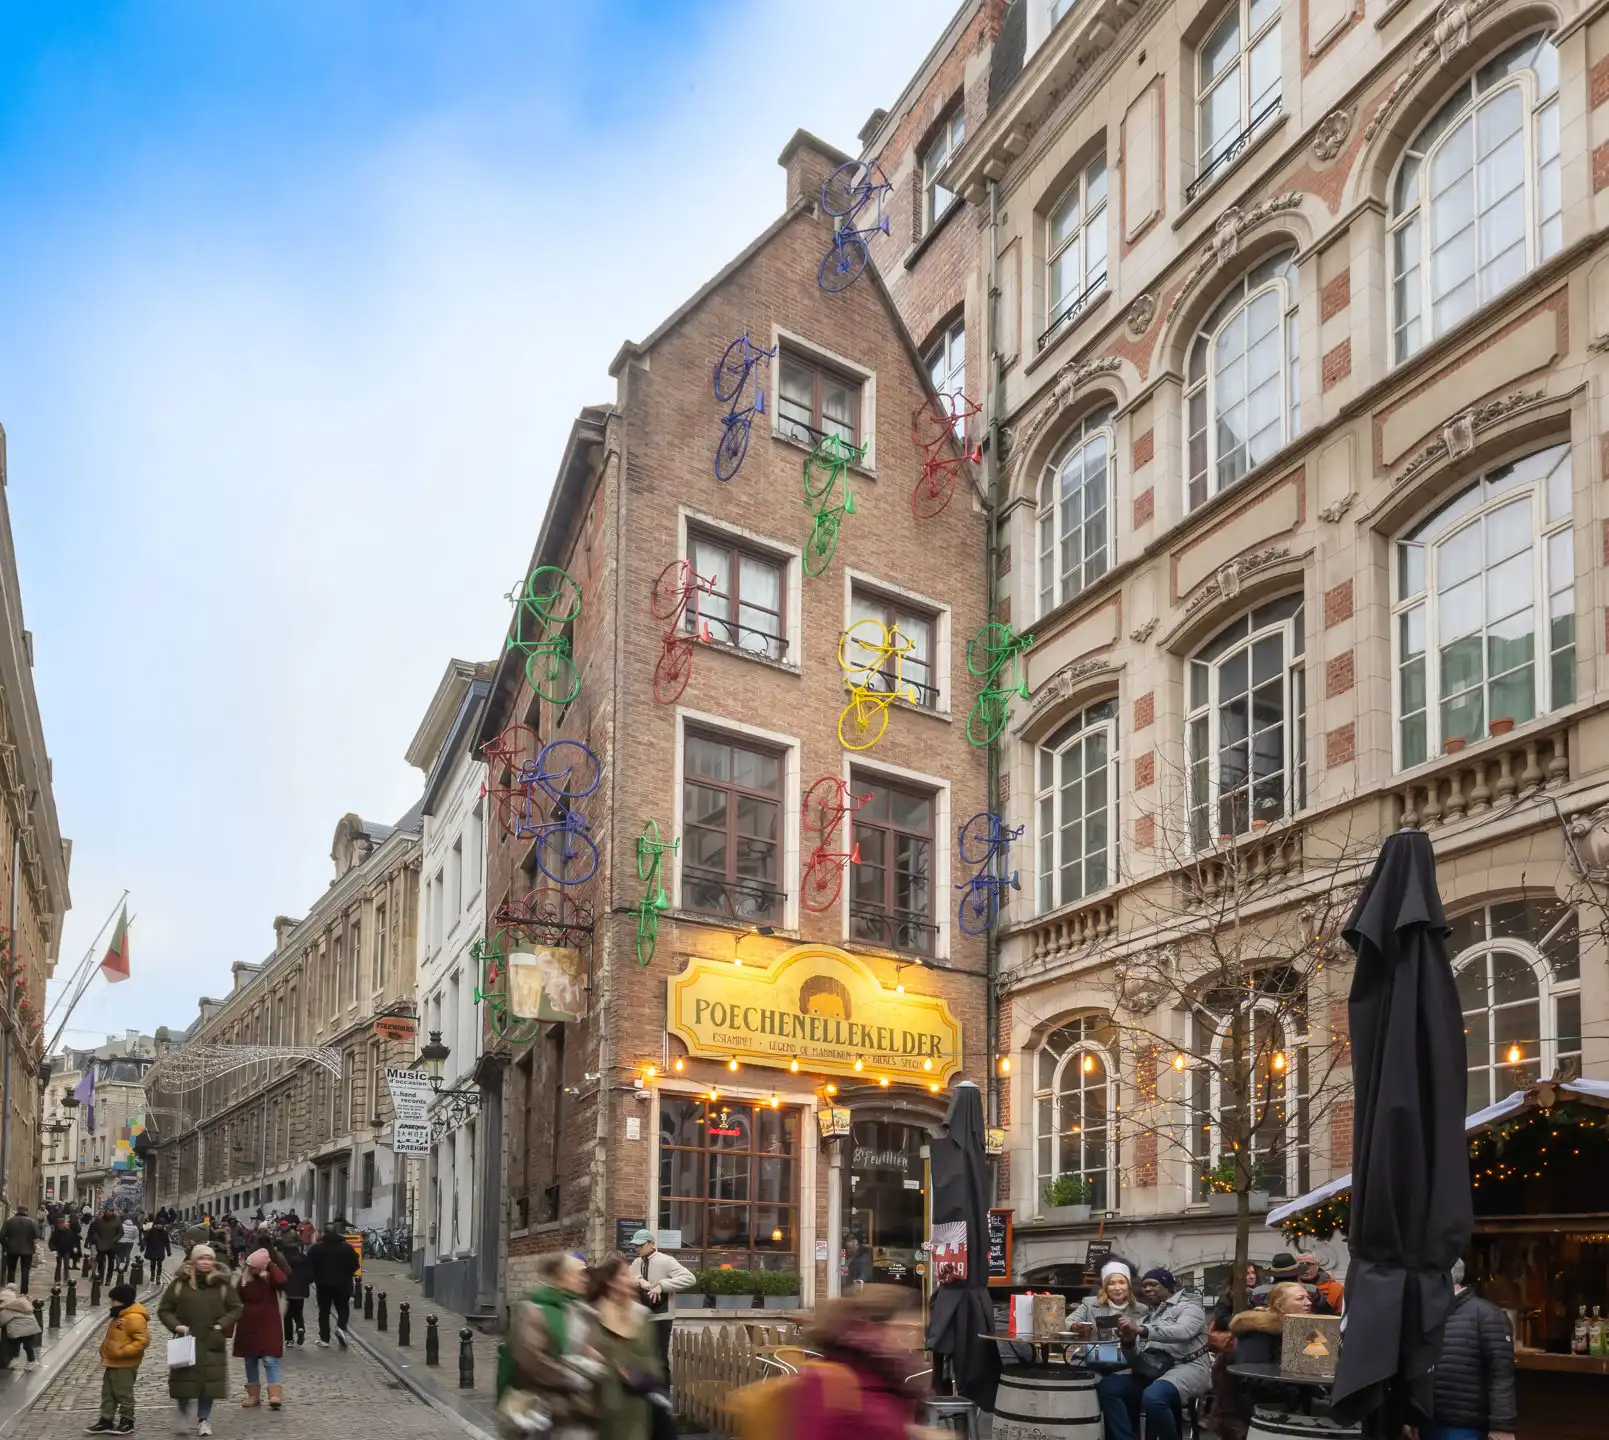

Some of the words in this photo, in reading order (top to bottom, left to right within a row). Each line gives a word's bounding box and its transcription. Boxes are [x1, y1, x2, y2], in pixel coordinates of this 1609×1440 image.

[694, 998, 943, 1058] POECHENELLEKELDER
[712, 1032, 752, 1047] ESTAMINET
[769, 1040, 796, 1053] LEGEND
[812, 1047, 851, 1061] MANNEKEN
[387, 1068, 428, 1081] Music
[389, 1078, 427, 1087] d'occasion
[396, 1144, 429, 1152] АРЛЕКИН
